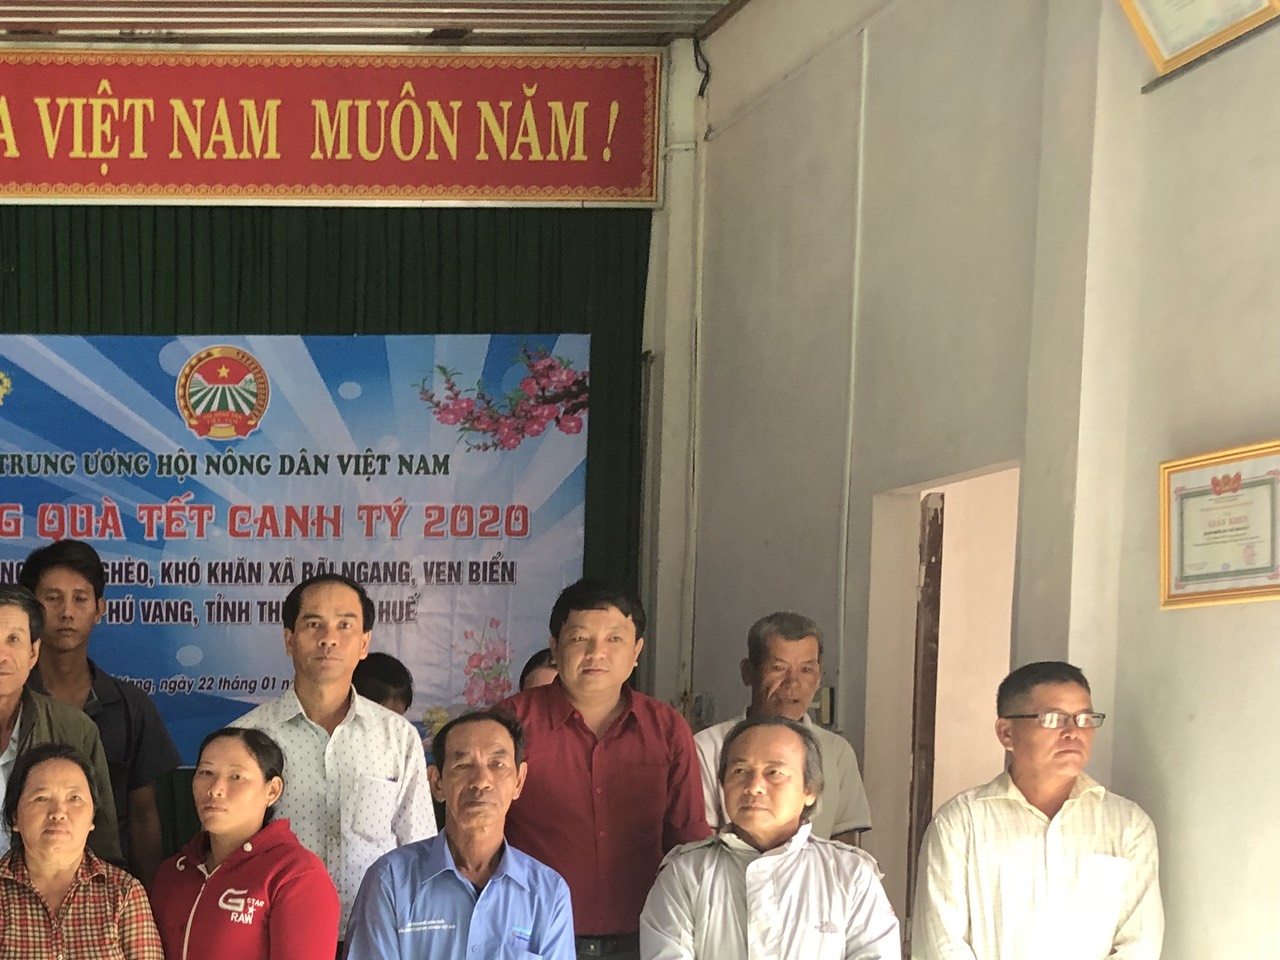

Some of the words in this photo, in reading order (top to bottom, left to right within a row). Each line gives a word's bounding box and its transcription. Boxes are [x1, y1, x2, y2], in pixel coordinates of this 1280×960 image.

[34, 79, 154, 176] VIỆT
[169, 98, 281, 160] NAM
[310, 82, 462, 162] MUÔN
[476, 82, 589, 162] NĂM
[83, 450, 149, 475] ƯƠNG
[156, 448, 198, 482] HỘI
[205, 448, 271, 475] NÔNG
[278, 448, 330, 475] DÂN
[337, 448, 391, 482] VIỆT
[398, 454, 450, 475] NAM
[37, 496, 124, 542] QUÀ
[137, 492, 214, 539] TẾT
[228, 504, 342, 539] CANH
[357, 497, 408, 539] TÝ
[423, 504, 529, 539] 2020
[160, 557, 200, 583] KHÓ
[207, 557, 262, 583] KHĂN
[269, 557, 295, 583] XÃ
[342, 561, 416, 586] NGANG,
[423, 561, 462, 583] VEN
[469, 551, 515, 583] BIỂN
[107, 596, 133, 622] HÚ
[141, 601, 198, 625] VANG,
[205, 593, 250, 622] TỈNH
[257, 601, 286, 622] TH
[378, 593, 420, 622] HUẾ
[160, 676, 194, 693] ngày
[198, 677, 215, 690] 22
[218, 675, 257, 694] tháng
[261, 676, 277, 690] 01
[230, 912, 253, 925] RAW
[247, 898, 265, 908] STAR
